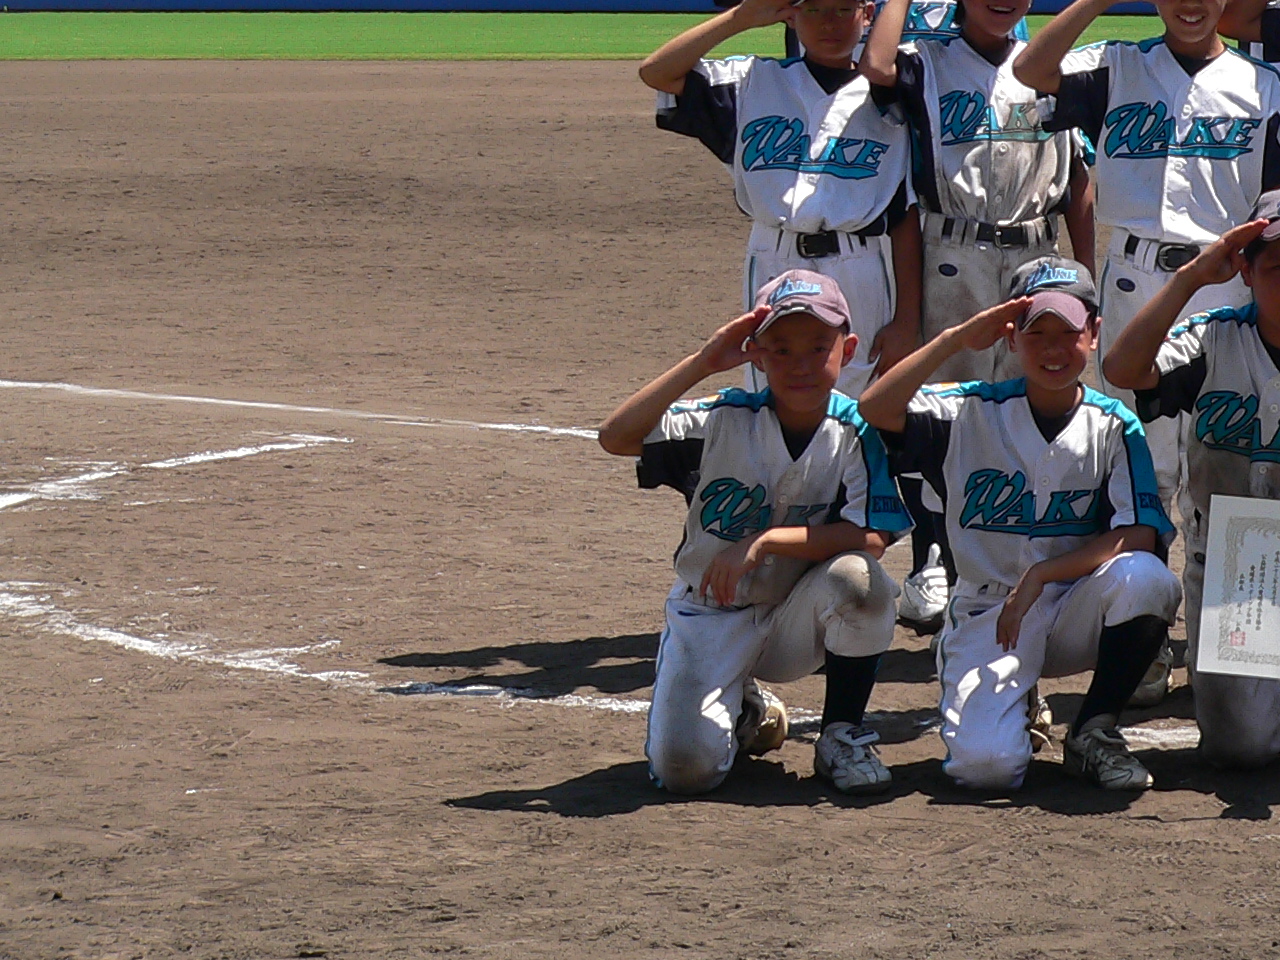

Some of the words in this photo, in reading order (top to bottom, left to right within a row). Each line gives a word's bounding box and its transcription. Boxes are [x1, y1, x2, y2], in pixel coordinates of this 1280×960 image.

[741, 115, 891, 179] WAKE
[939, 90, 1054, 146] WAK
[1104, 100, 1262, 160] WAKE
[701, 477, 835, 540] WAK
